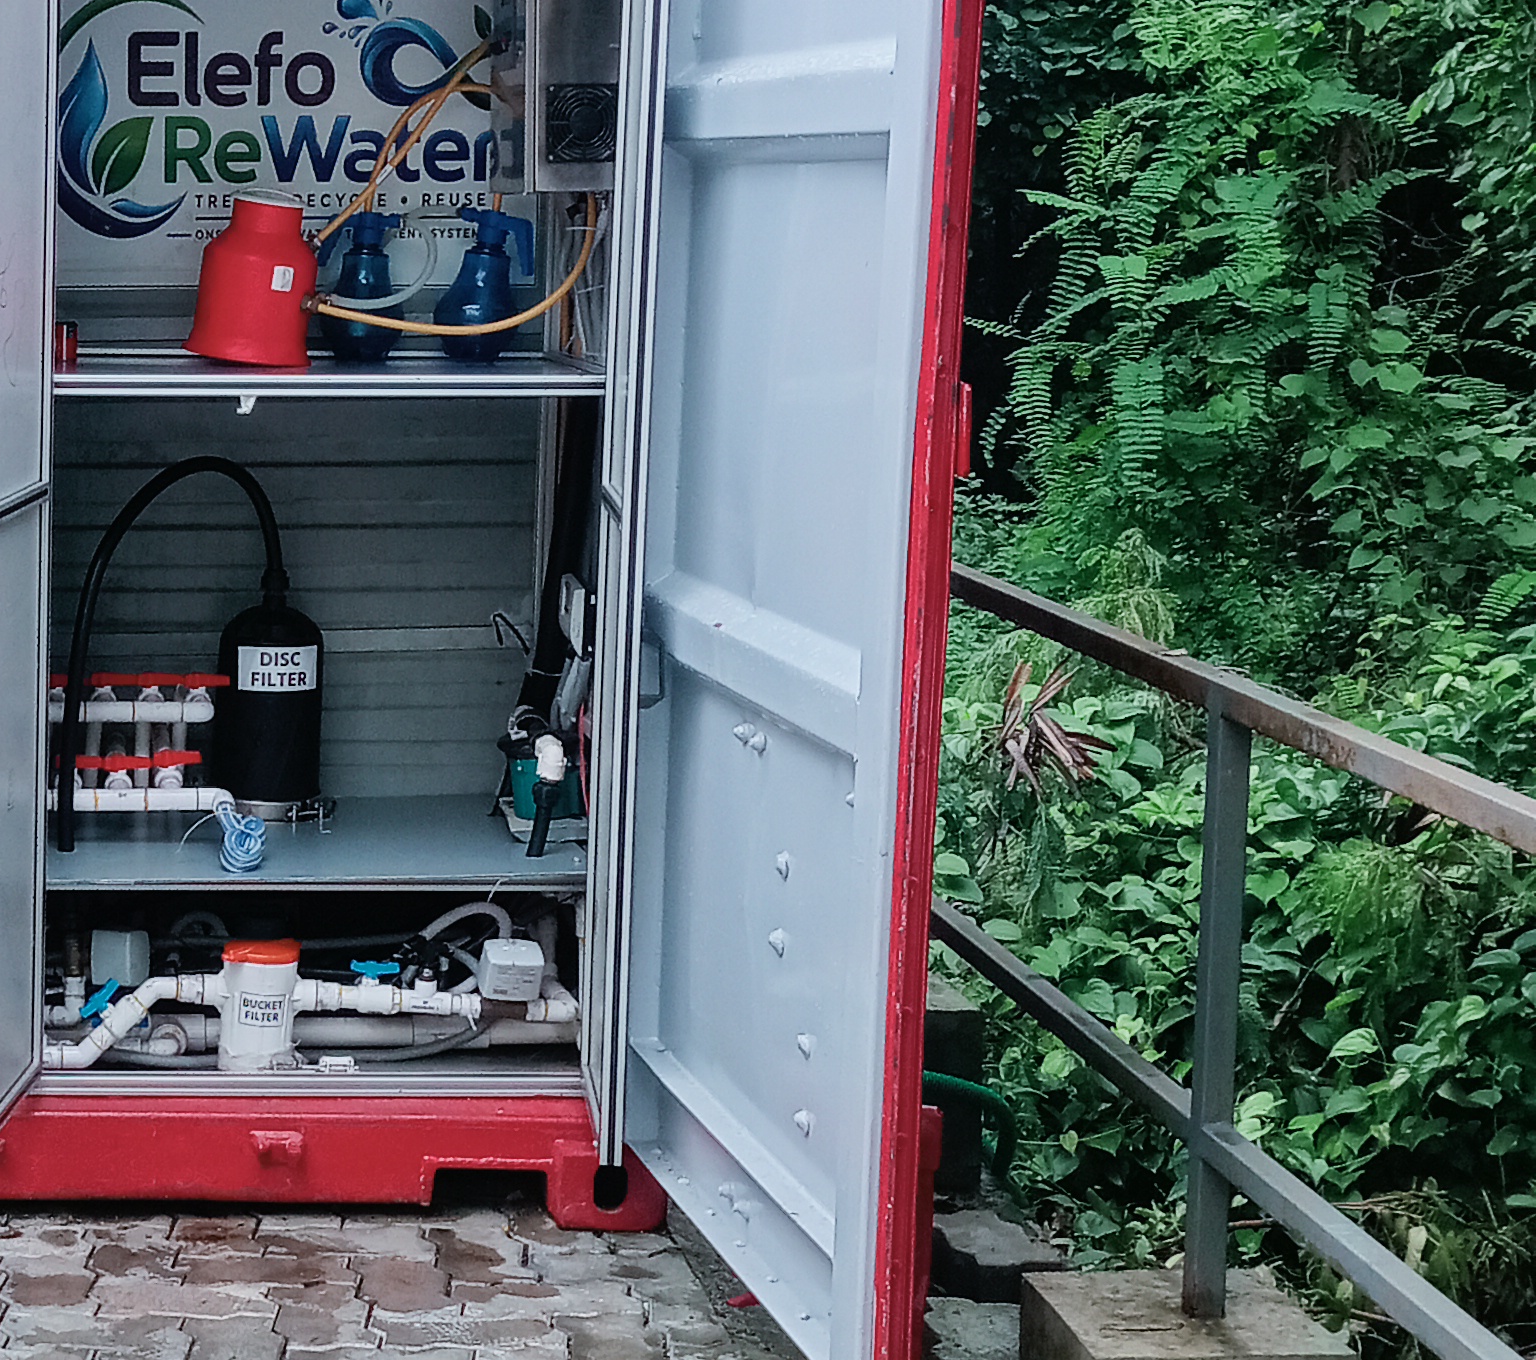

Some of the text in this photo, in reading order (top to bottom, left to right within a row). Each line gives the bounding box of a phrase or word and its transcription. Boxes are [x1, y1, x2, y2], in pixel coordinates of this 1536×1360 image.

[127, 31, 335, 107] Elefo
[163, 115, 495, 184] ReWater
[421, 192, 486, 207] REUSE
[260, 652, 301, 667] DISC
[251, 671, 307, 687] FILTER
[243, 997, 283, 1010] BUCKET
[245, 1010, 279, 1022] FILTER
